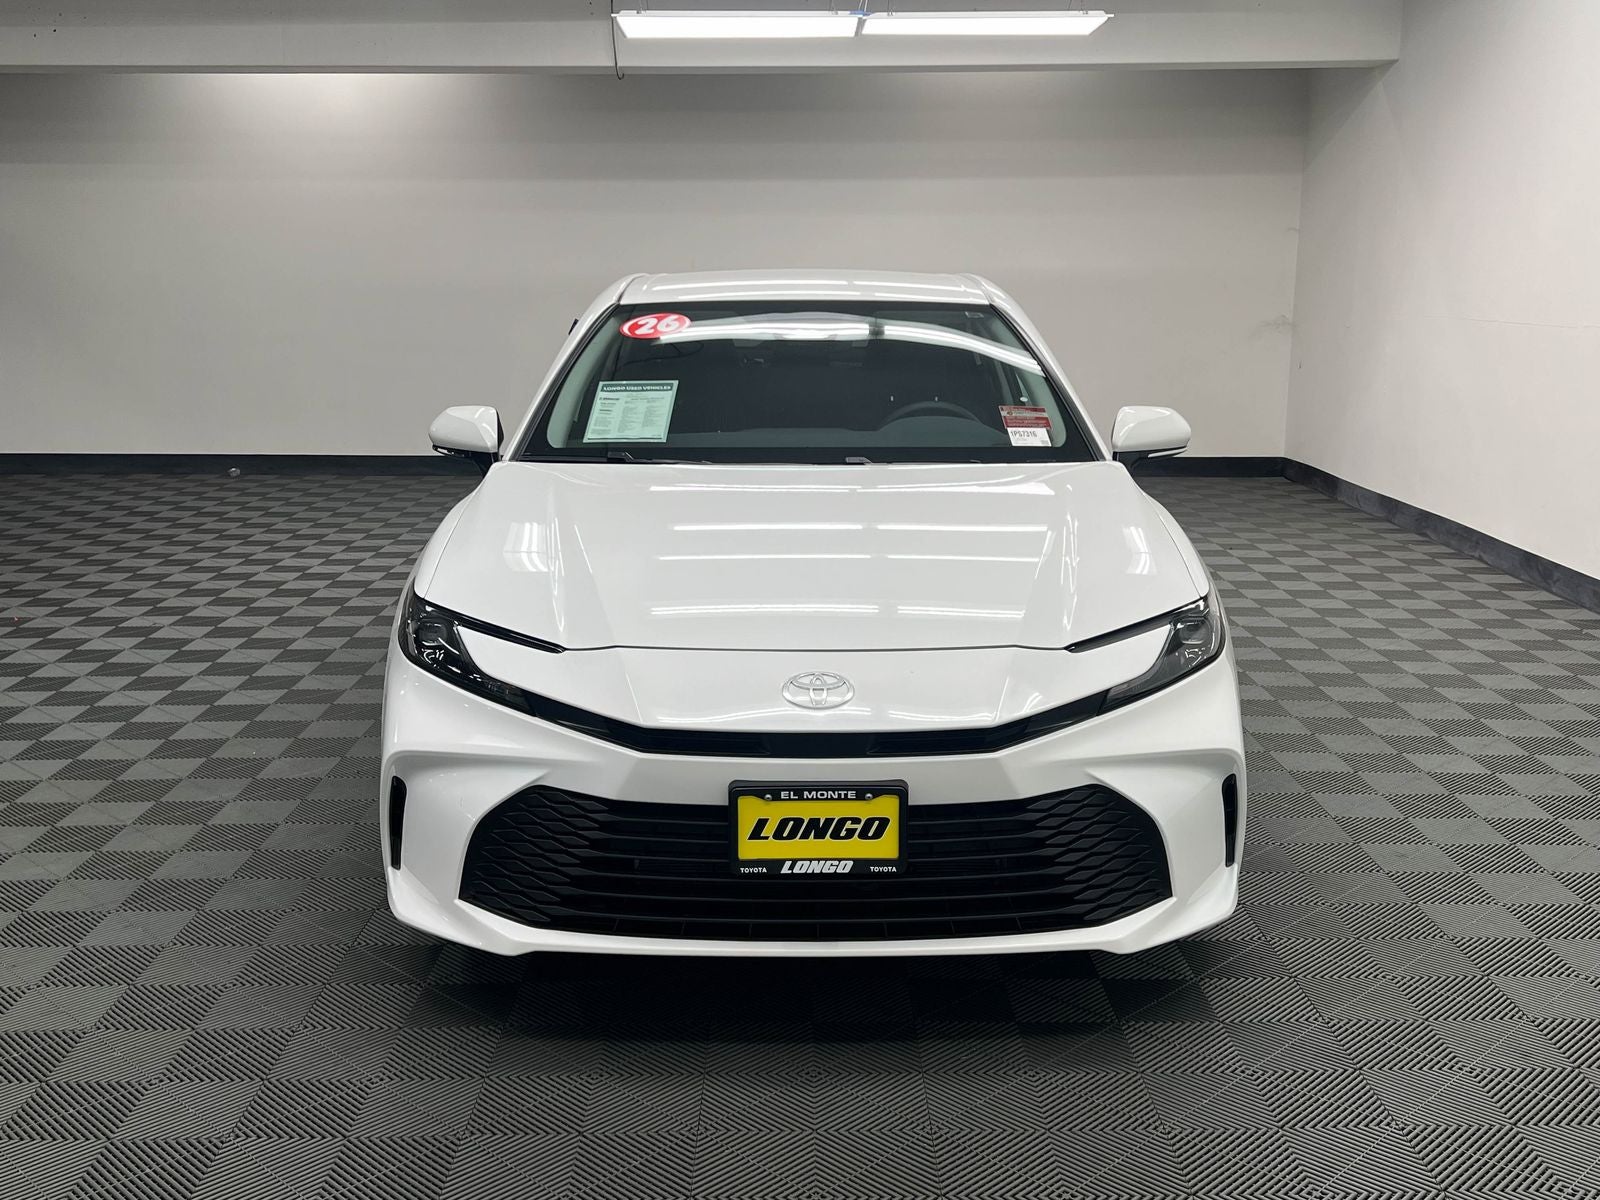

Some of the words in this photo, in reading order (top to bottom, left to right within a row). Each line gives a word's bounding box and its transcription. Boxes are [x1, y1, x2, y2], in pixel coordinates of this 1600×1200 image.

[635, 314, 679, 335] 26
[780, 791, 798, 799] EL
[803, 791, 856, 799] MONTE
[747, 817, 891, 841] LONGO
[780, 860, 854, 874] LONGO
